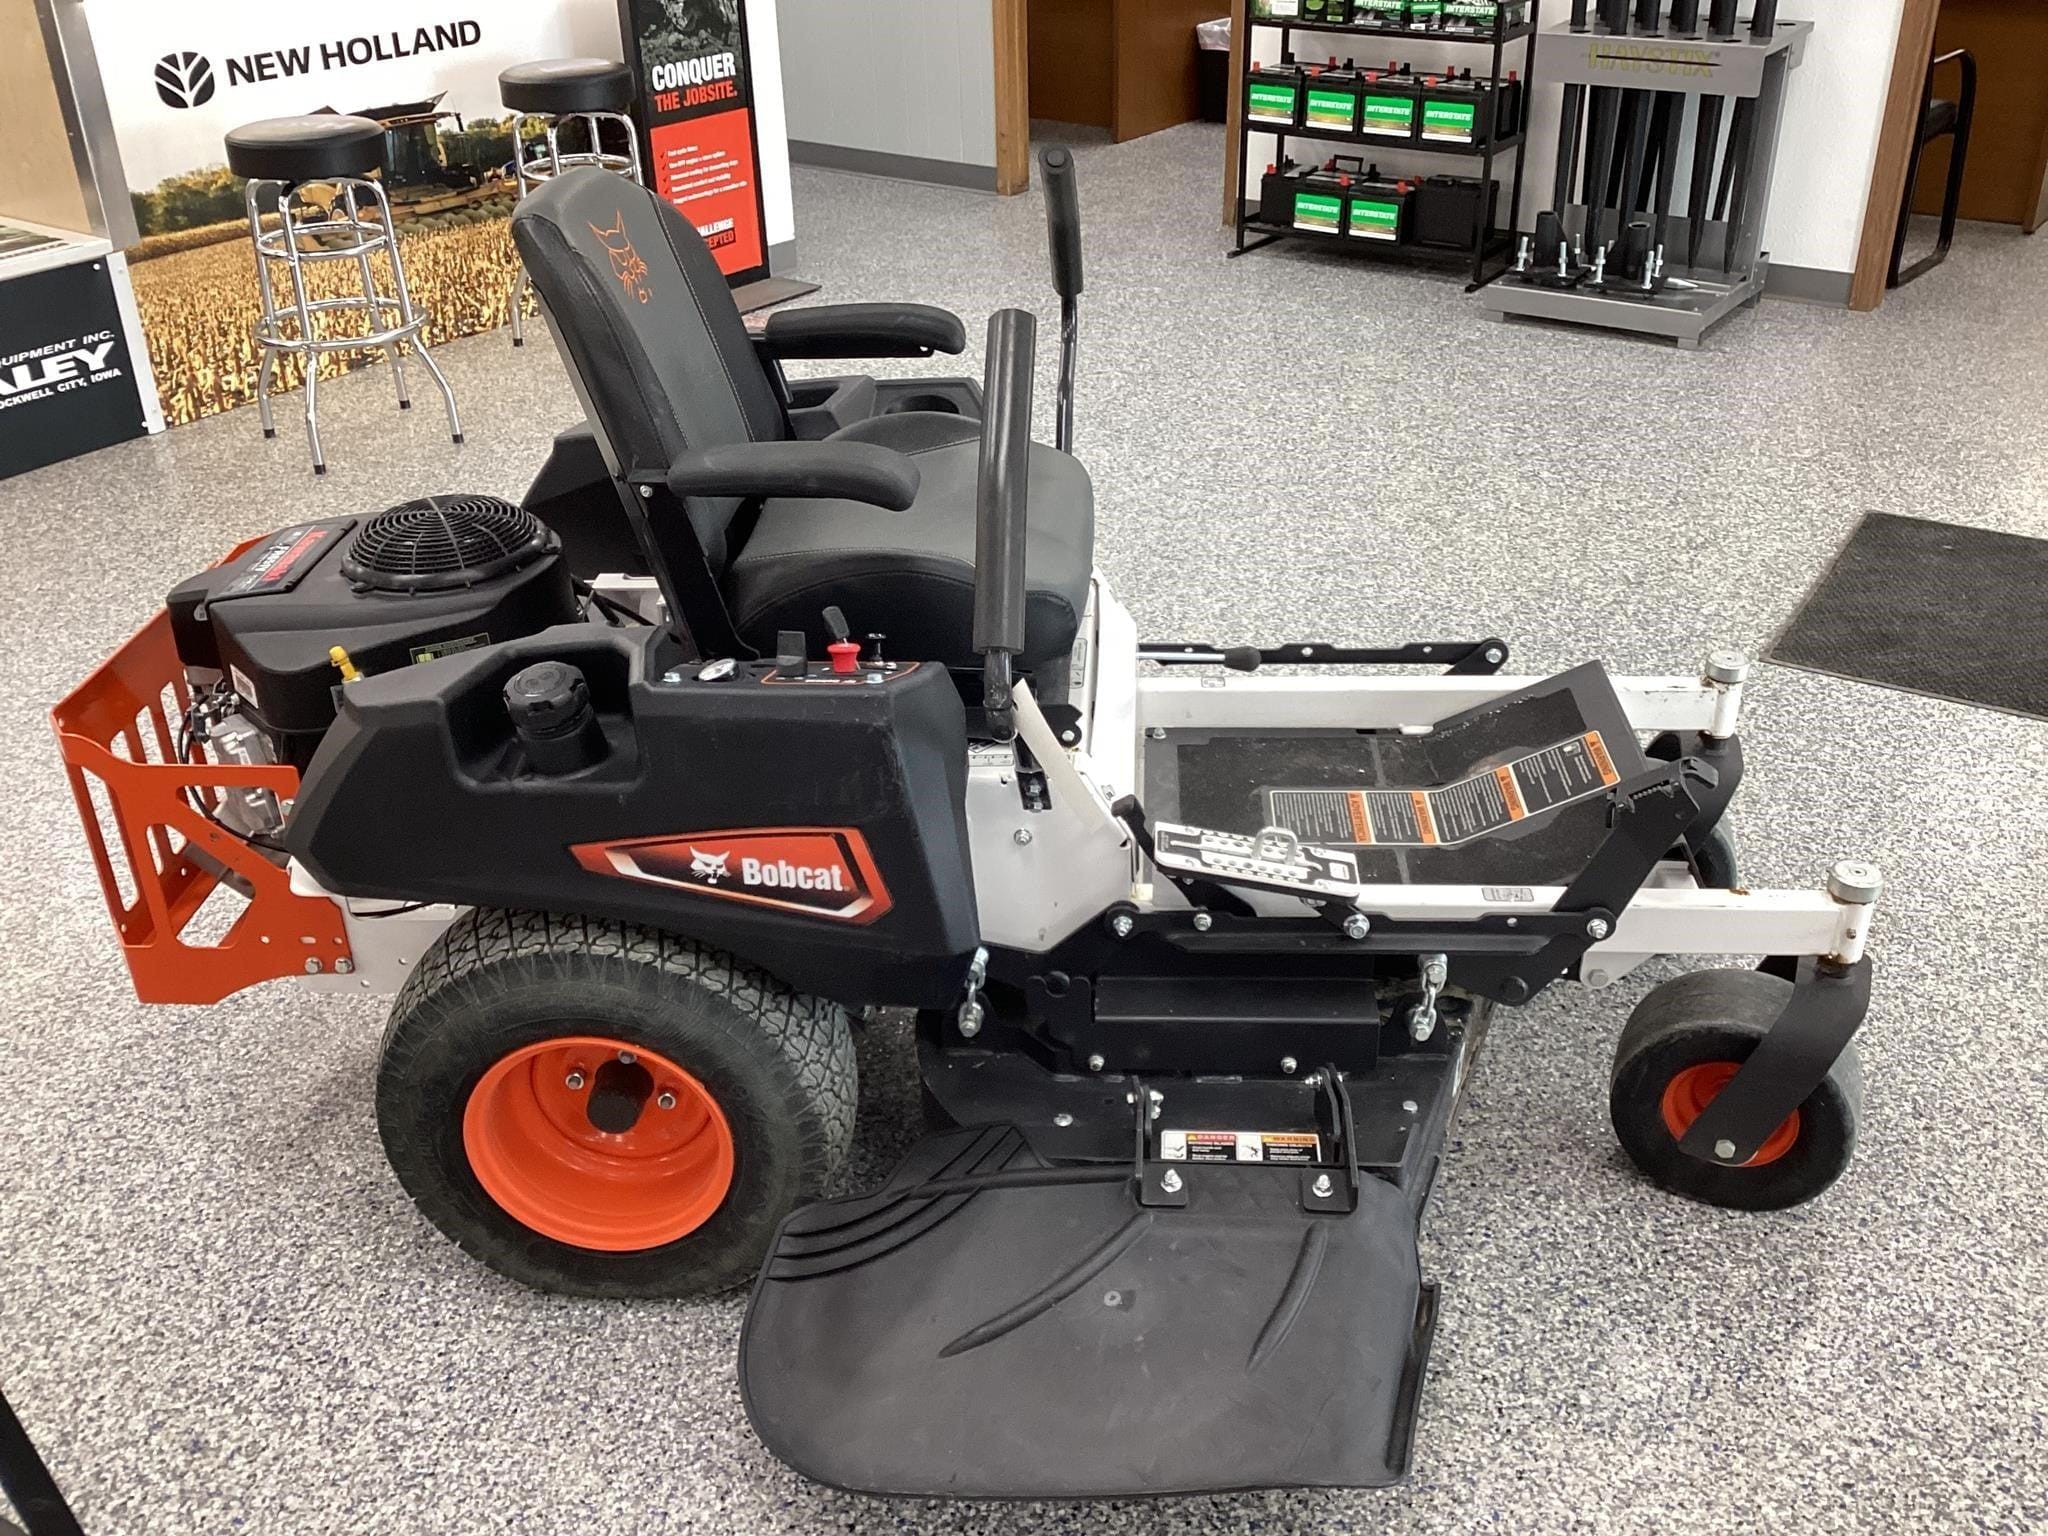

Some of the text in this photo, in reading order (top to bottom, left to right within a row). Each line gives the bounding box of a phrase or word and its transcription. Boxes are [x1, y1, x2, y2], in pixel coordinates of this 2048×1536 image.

[226, 20, 481, 86] NEW HOLLAND
[652, 52, 736, 91] CONQUER
[654, 80, 738, 113] THE JOBSITE.
[696, 217, 734, 237] ALLENGE
[0, 330, 115, 368] UIPMENT INC.
[57, 377, 88, 393] CITY,
[90, 368, 122, 383] IOWA
[742, 857, 843, 892] Bobcat
